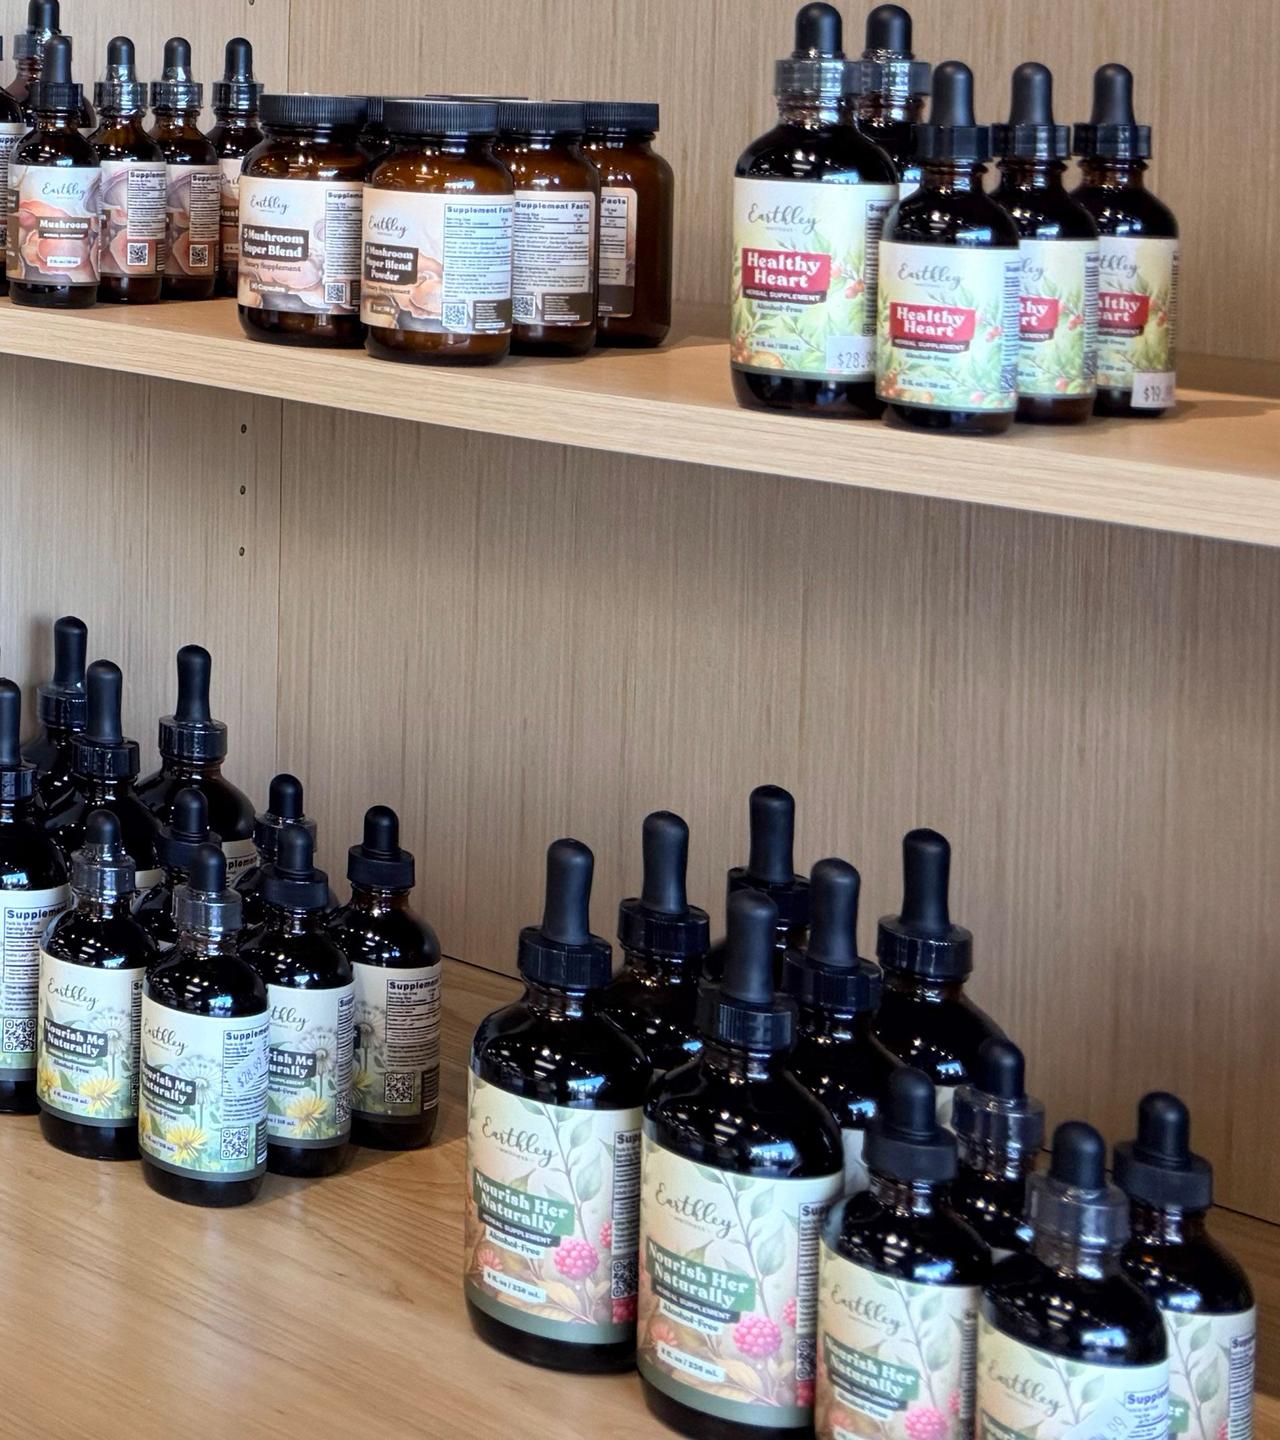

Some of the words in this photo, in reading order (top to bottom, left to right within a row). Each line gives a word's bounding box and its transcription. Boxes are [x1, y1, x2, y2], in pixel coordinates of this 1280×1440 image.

[447, 205, 497, 214] Supplement
[515, 201, 569, 210] Supplement
[40, 221, 88, 230] Mushroom
[748, 203, 818, 235] Earthley
[249, 230, 305, 245] Mushroom
[244, 243, 266, 256] Super
[268, 245, 303, 258] Blend
[370, 246, 414, 260] Mushroom
[385, 260, 412, 271] Blend
[747, 252, 820, 276] Healthy
[370, 270, 400, 282] Powder
[754, 269, 809, 288] Heart
[898, 263, 961, 291] Earthley
[770, 291, 821, 302] SUPPLEMENT
[897, 307, 965, 327] Healthy
[904, 321, 954, 337] Heart
[48, 977, 99, 1011] Earthley
[46, 1020, 83, 1041] Nourish
[86, 1034, 105, 1046] Me
[48, 1033, 100, 1057] Naturally
[269, 1063, 308, 1078] urally
[295, 1056, 314, 1066] Me
[175, 1080, 193, 1093] Me
[482, 1116, 558, 1168] Earthley
[476, 1176, 530, 1210] Nourish
[534, 1199, 568, 1219] Her
[481, 1194, 555, 1235] Naturally
[656, 1183, 737, 1240] Earthley
[490, 1231, 541, 1256] Alcohol-Free
[504, 1224, 551, 1245] SUPPLEMENT
[649, 1241, 707, 1282] Nourish
[712, 1272, 749, 1293] Her
[655, 1265, 735, 1310] Naturally
[663, 1304, 719, 1333] Alcohol-Free
[678, 1297, 731, 1320] SUPPLEMENT
[831, 1354, 904, 1398] Naturally
[881, 1365, 915, 1385] Her
